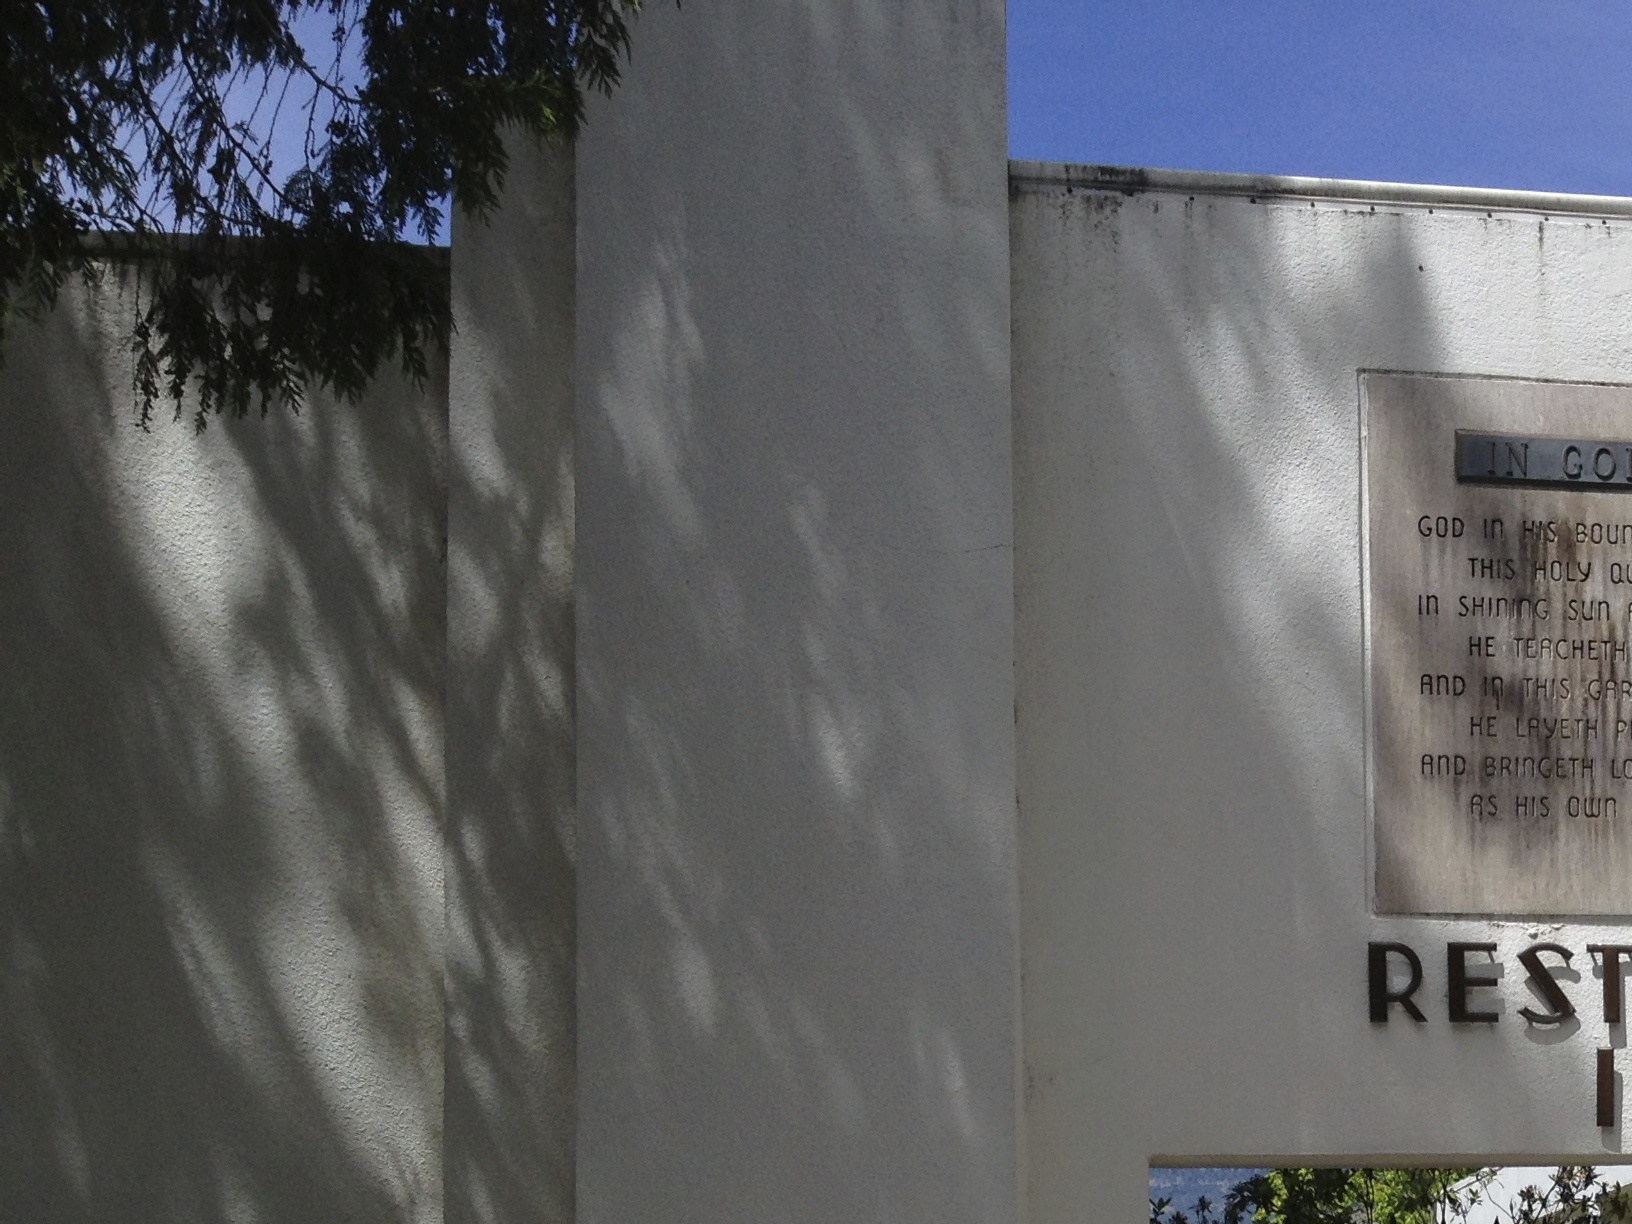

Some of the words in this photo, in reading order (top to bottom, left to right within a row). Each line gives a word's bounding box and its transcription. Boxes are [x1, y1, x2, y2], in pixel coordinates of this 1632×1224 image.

[1487, 441, 1529, 477] IN
[1418, 515, 1464, 538] GOD
[1483, 518, 1503, 539] IN
[1523, 520, 1557, 542] HIS
[1468, 558, 1515, 580] THIS
[1534, 560, 1591, 582] HOLY
[1418, 594, 1438, 615] IN
[1458, 595, 1549, 620] SHINING
[1568, 599, 1610, 621] SUN
[1468, 636, 1495, 657] HE
[1513, 637, 1626, 661] TEACHETH
[1420, 674, 1466, 696] AND
[1483, 676, 1503, 696] IN
[1523, 678, 1570, 699] THIS
[1470, 716, 1497, 737] HE
[1516, 718, 1598, 739] LAYETH
[1421, 754, 1466, 776] AND
[1485, 756, 1594, 778] BRINGETH
[1471, 794, 1497, 818] AS
[1516, 796, 1550, 818] HIS
[1568, 797, 1616, 818] OWN
